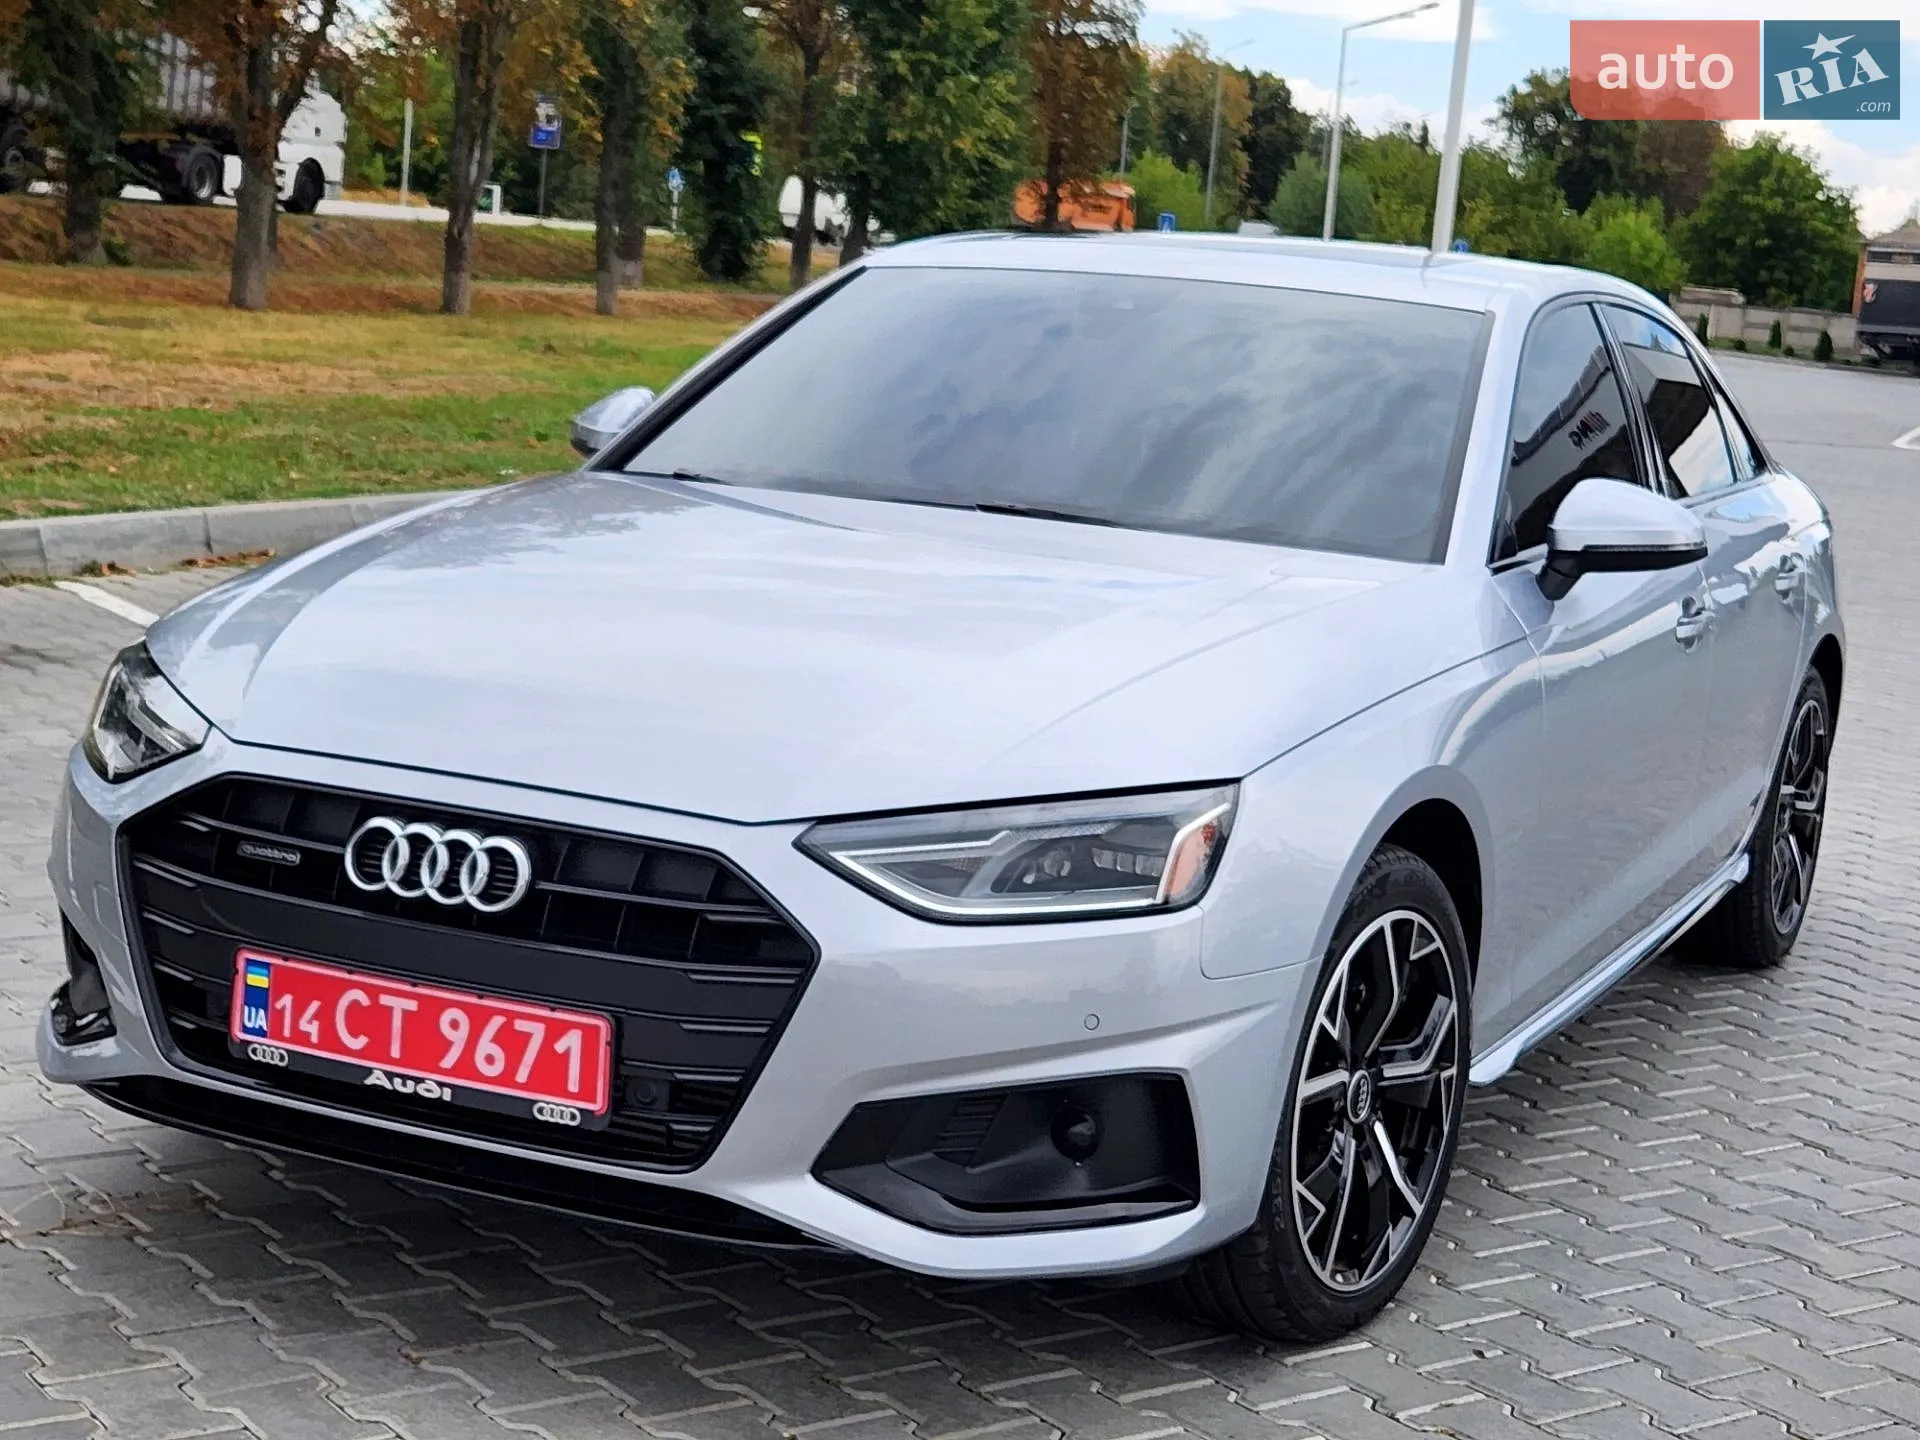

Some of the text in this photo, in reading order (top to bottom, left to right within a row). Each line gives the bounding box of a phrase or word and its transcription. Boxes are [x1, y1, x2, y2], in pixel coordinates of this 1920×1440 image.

[243, 1005, 268, 1032] UA
[439, 1008, 583, 1093] 9671
[363, 1069, 452, 1101] Audi
